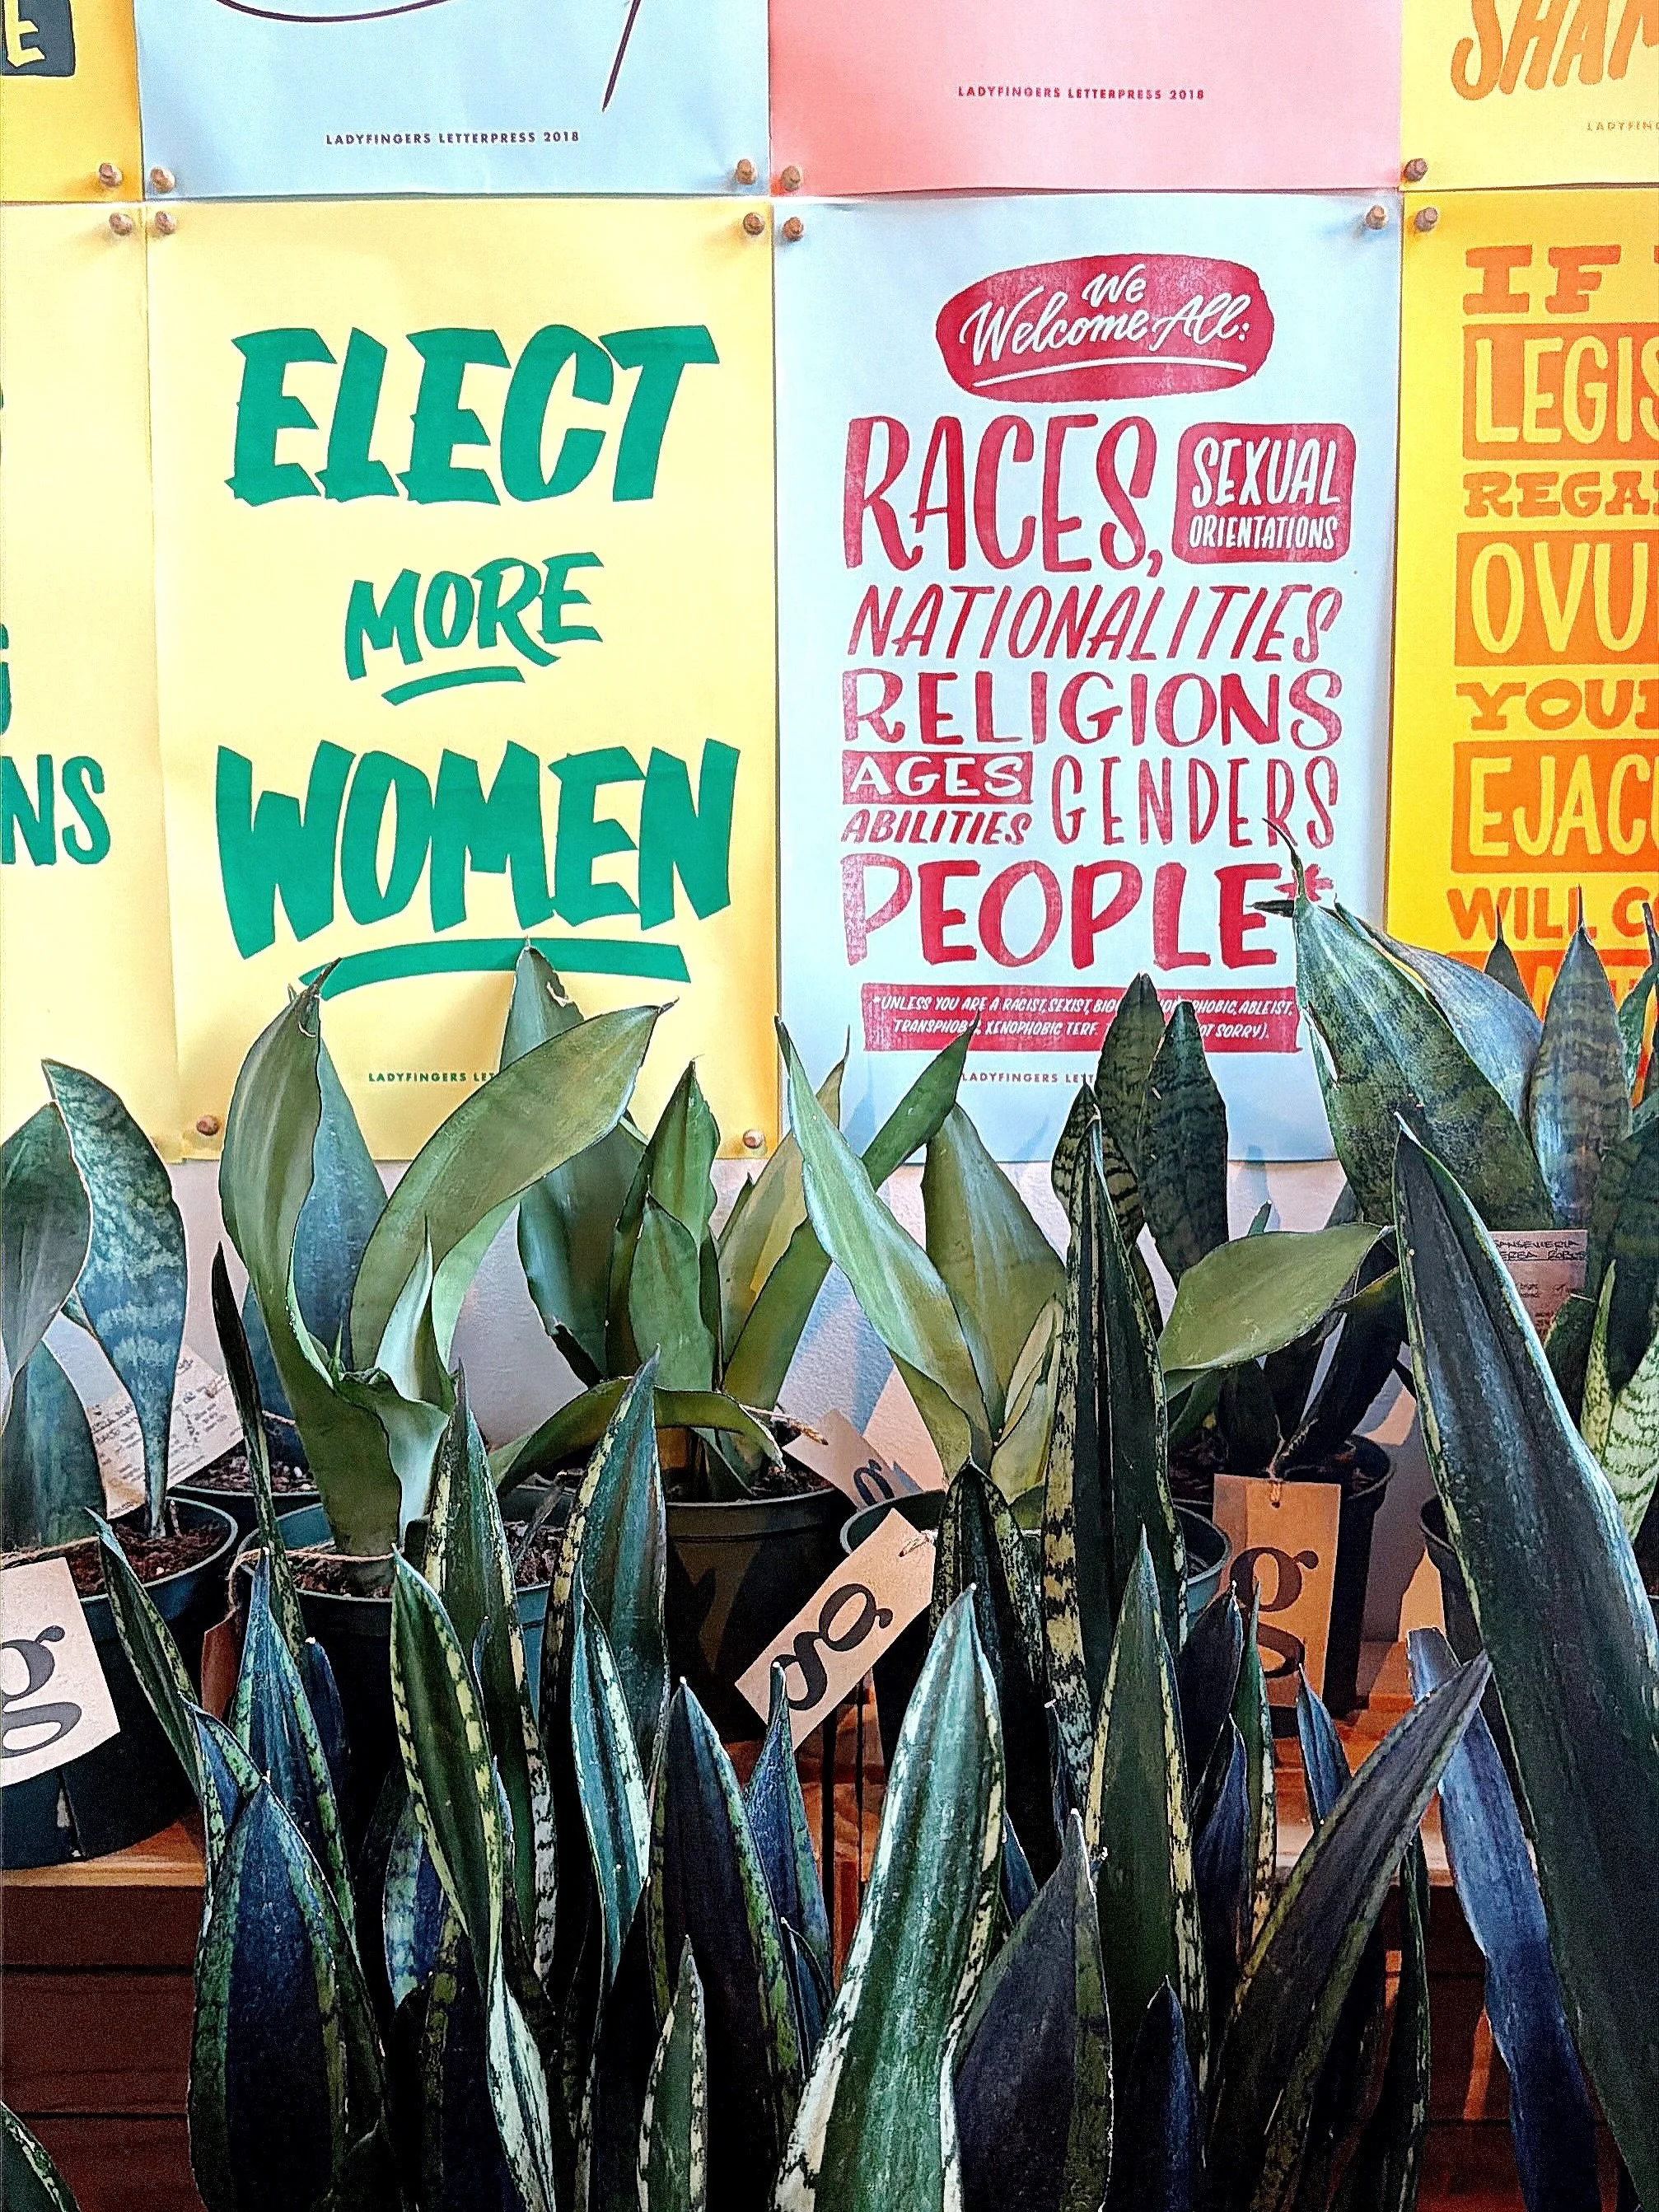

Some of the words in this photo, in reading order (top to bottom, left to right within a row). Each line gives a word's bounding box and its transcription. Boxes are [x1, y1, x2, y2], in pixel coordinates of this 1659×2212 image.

[958, 86, 1061, 98] LADYFINGERS
[1068, 87, 1161, 100] LETTERPRESS
[1169, 89, 1204, 100] 2018
[326, 133, 431, 144] LADYFINGERS
[439, 132, 535, 143] LETTERPRESS
[544, 131, 579, 142] 2018
[1082, 263, 1147, 307] We
[1462, 244, 1622, 314] IF
[959, 285, 1147, 367] Welcome
[225, 324, 719, 507] ELECT
[844, 414, 1163, 578] RACES,
[1192, 437, 1341, 509] SEXUAL
[1463, 471, 1659, 517] REGA
[1189, 514, 1339, 550] ORIENTATIONS
[345, 551, 605, 681] MORE
[848, 584, 1343, 662] NATIONALITIES
[1470, 541, 1659, 654] OVU
[841, 668, 1343, 751] RELIGIONS
[849, 755, 1023, 797] AGES
[1052, 755, 1339, 849] GENDERS
[1470, 754, 1659, 856] EJAC
[216, 738, 740, 959] WOMEN
[841, 809, 1032, 845] ABILITIES
[935, 997, 959, 1011] YOU
[961, 996, 988, 1011] ARE
[989, 997, 1002, 1011] A
[985, 1020, 1063, 1036] XENOPHOBIC
[368, 1073, 467, 1083] LADYFINGERS
[962, 1073, 1058, 1083] LADYFINGERS
